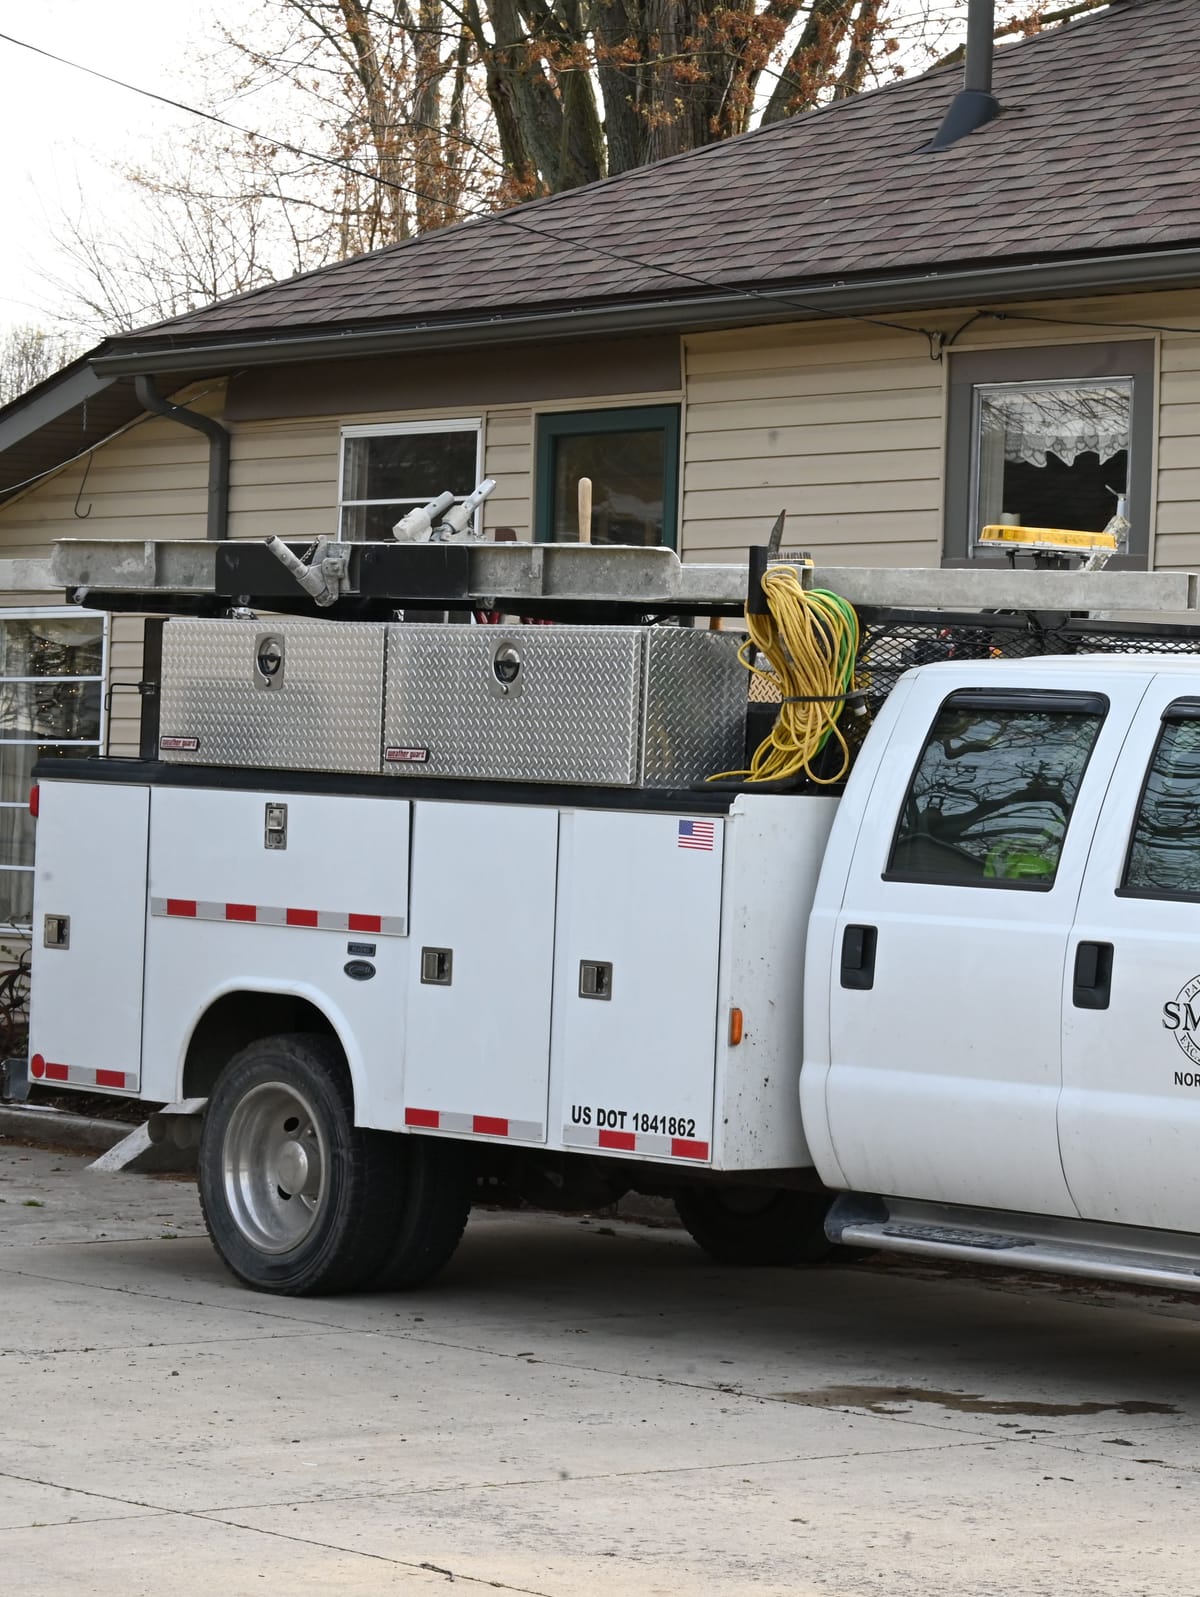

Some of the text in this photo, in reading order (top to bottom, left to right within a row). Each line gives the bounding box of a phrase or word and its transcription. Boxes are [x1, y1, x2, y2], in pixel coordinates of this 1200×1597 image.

[571, 1105, 696, 1138] US DOT 1841862
